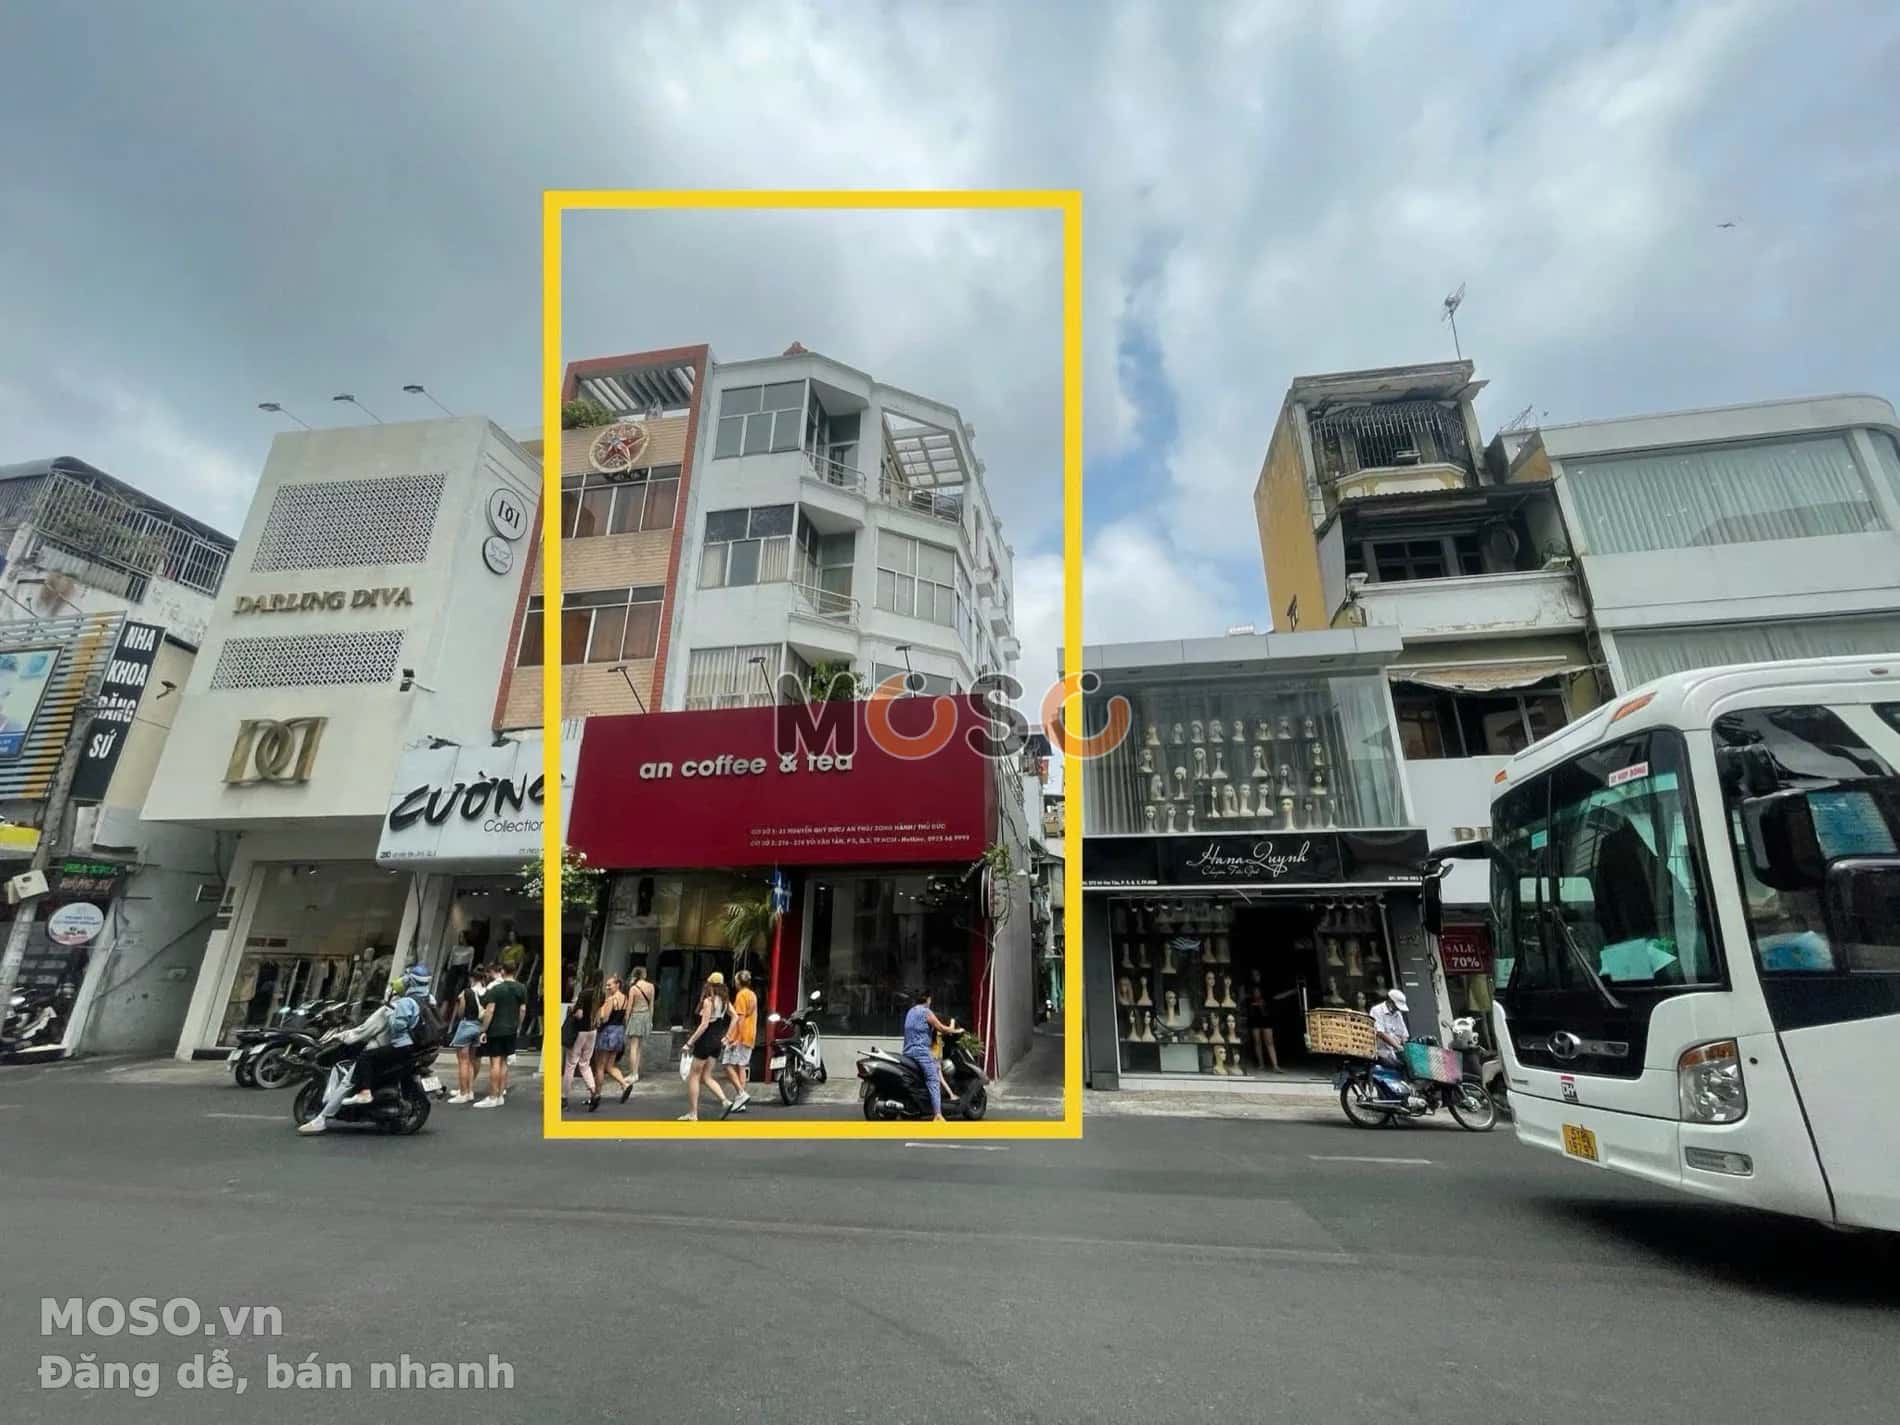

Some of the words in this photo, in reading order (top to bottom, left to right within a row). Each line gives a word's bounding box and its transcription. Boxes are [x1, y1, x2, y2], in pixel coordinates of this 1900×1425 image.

[233, 591, 346, 617] DARLING
[350, 587, 413, 609] DIVA
[124, 625, 157, 652] NHA
[107, 660, 149, 687] KHOA
[95, 692, 137, 723] RĂNG
[88, 728, 117, 760] SỨ
[639, 761, 673, 779] an
[681, 754, 767, 777] coffee
[779, 752, 799, 773] &
[806, 753, 853, 772] tea
[1452, 957, 1480, 968] 70%
